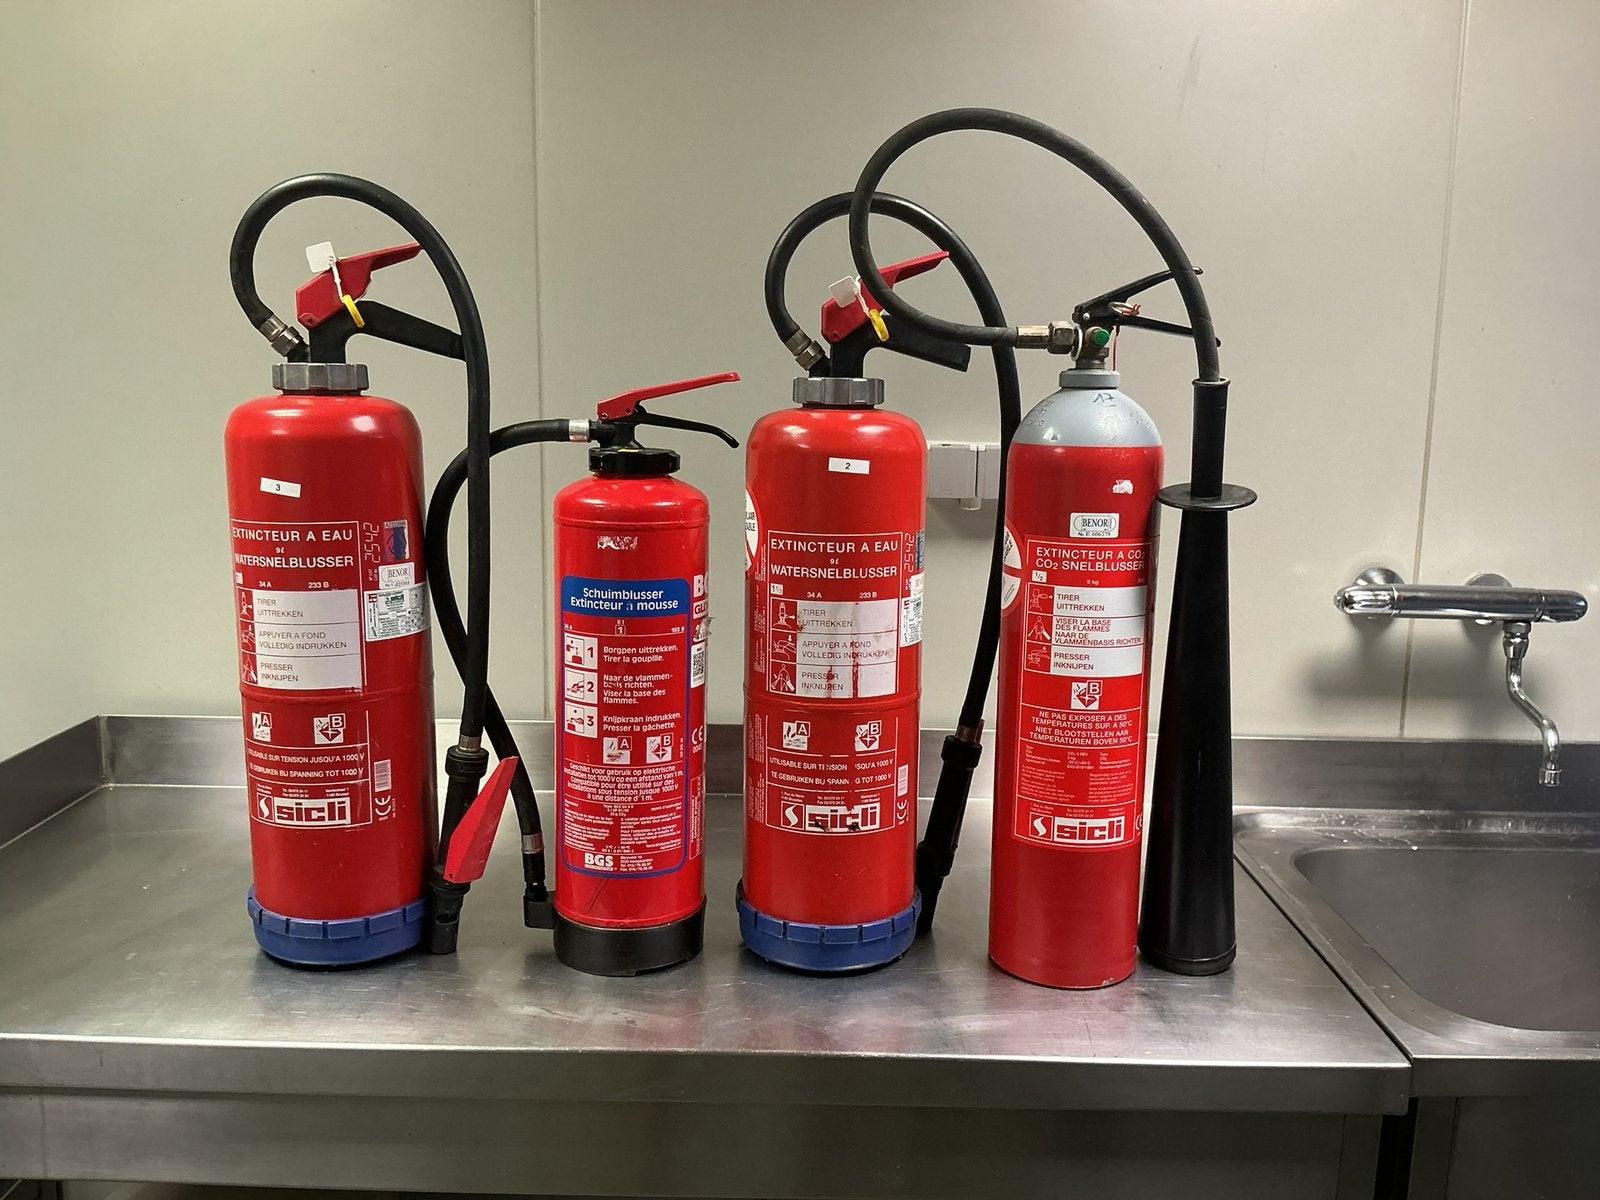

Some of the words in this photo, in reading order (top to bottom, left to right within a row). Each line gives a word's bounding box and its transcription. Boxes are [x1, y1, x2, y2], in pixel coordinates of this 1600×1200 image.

[1082, 519, 1108, 527] BENOR
[233, 527, 300, 541] EXTINCTEUR
[306, 531, 316, 541] A
[323, 530, 352, 541] EAU
[771, 538, 855, 553] EXTINCTEUR
[861, 544, 869, 552] A
[874, 540, 898, 551] EAU
[1036, 547, 1113, 560] EXTINCTEUR
[235, 556, 354, 568] WATERSNELBLUSSER
[1062, 561, 1144, 571] SNELBLUSSER
[771, 564, 897, 579] WATERSNELBLUSSER
[583, 587, 663, 600] Schuimblusser
[571, 597, 623, 610] Extincteur
[637, 599, 678, 611] mousse
[803, 619, 852, 628] UITTREKKEN
[259, 641, 294, 650] VOLLEDIG
[604, 646, 636, 655] Borgpen
[587, 647, 593, 658] 1
[802, 651, 842, 659] VOLLEDIG
[261, 663, 293, 671] PRESSER
[1053, 661, 1094, 670] INKNIJPEN
[261, 673, 298, 681] INKNIJPEN
[587, 681, 594, 692] 2
[1090, 684, 1099, 693] B
[262, 714, 270, 726] A
[332, 716, 343, 727] B
[587, 716, 594, 726] 3
[603, 715, 643, 723] Knijpkraan
[1032, 717, 1092, 729] TEMPERATURES
[798, 724, 808, 735] A
[870, 723, 879, 734] B
[1035, 726, 1052, 734] NIET
[1055, 728, 1114, 737] BLOOTSTELLEN
[620, 738, 629, 748] A
[663, 736, 671, 745] B
[1030, 732, 1091, 744] TEMPERATUREN
[281, 755, 308, 763] TENSION
[310, 755, 341, 763] JUSQU'A
[770, 757, 801, 769] UTILISABLE
[607, 768, 631, 776] gebruik
[643, 765, 675, 774] elektrische
[639, 772, 662, 782] afstand
[778, 772, 813, 783] GEBRUIKEN
[862, 775, 873, 784] TOT
[601, 781, 615, 789] pour
[614, 787, 637, 796] tension
[277, 801, 346, 822] sicli
[1057, 819, 1122, 840] sicli
[585, 853, 613, 867] BGS
